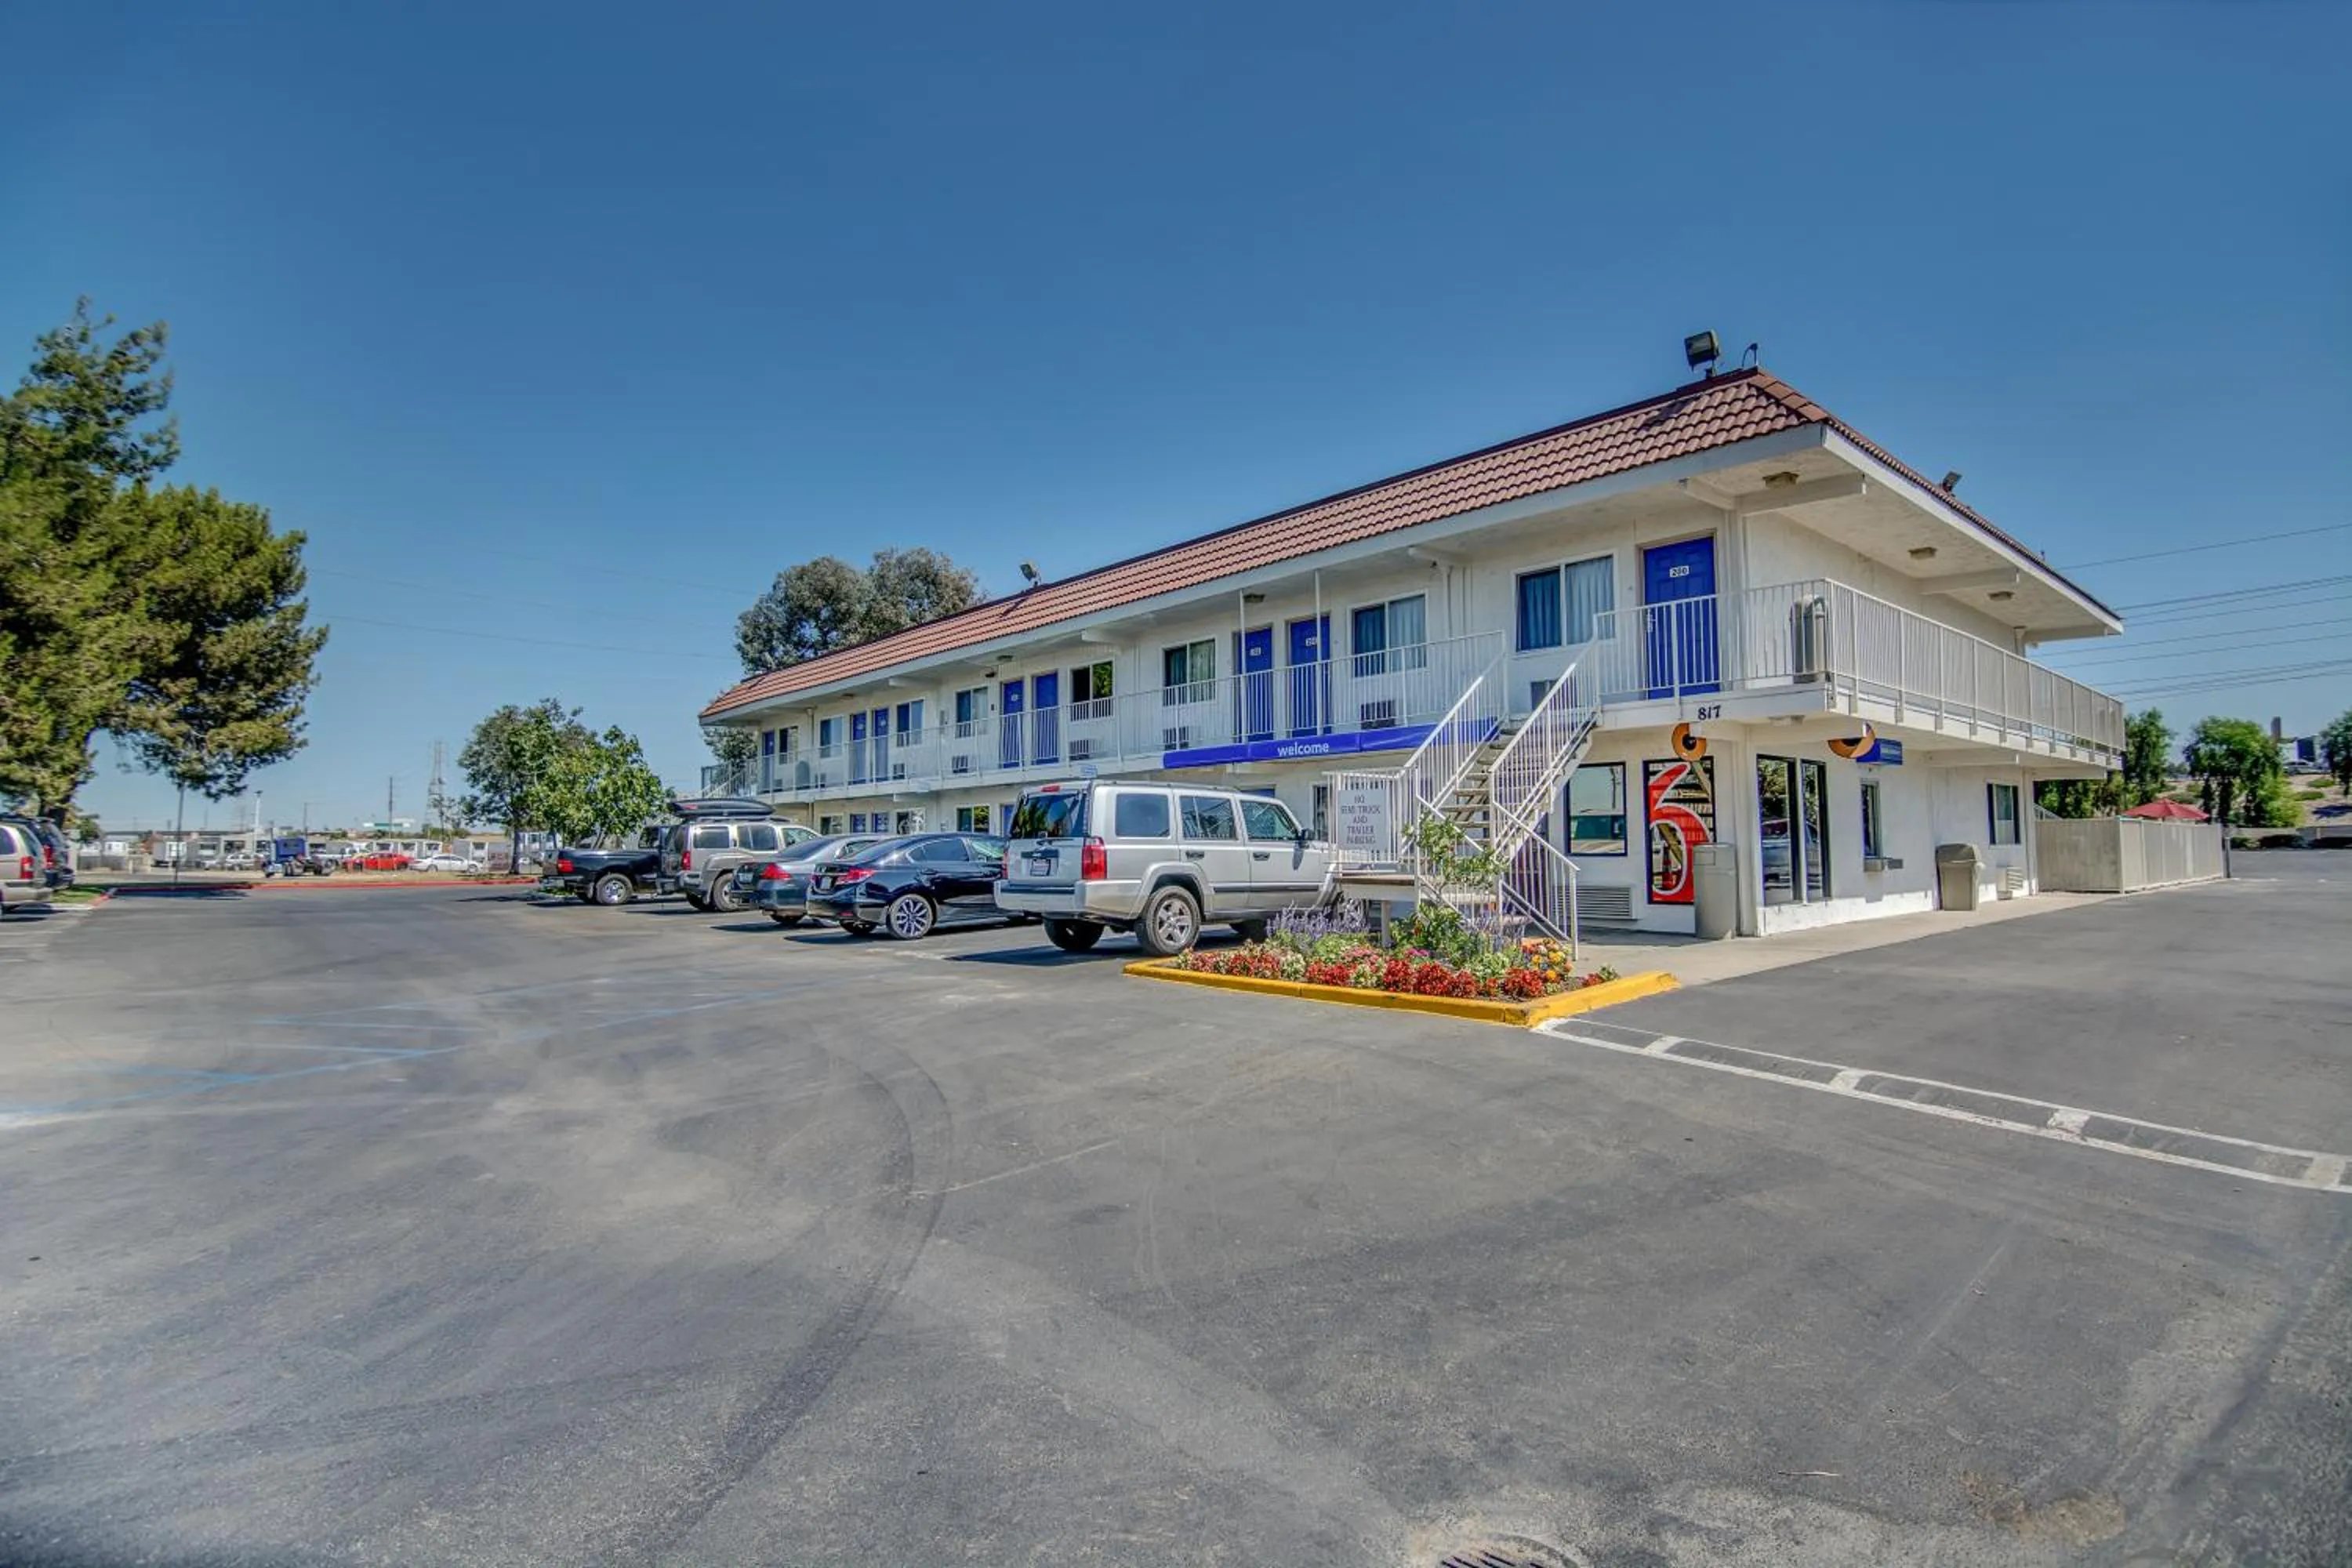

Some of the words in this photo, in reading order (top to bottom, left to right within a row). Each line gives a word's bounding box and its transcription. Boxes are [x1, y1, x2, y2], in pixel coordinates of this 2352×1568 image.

[1697, 705, 1721, 720] 817
[1277, 742, 1329, 757] welcome
[1354, 794, 1365, 804] NO
[1352, 815, 1368, 824] AND
